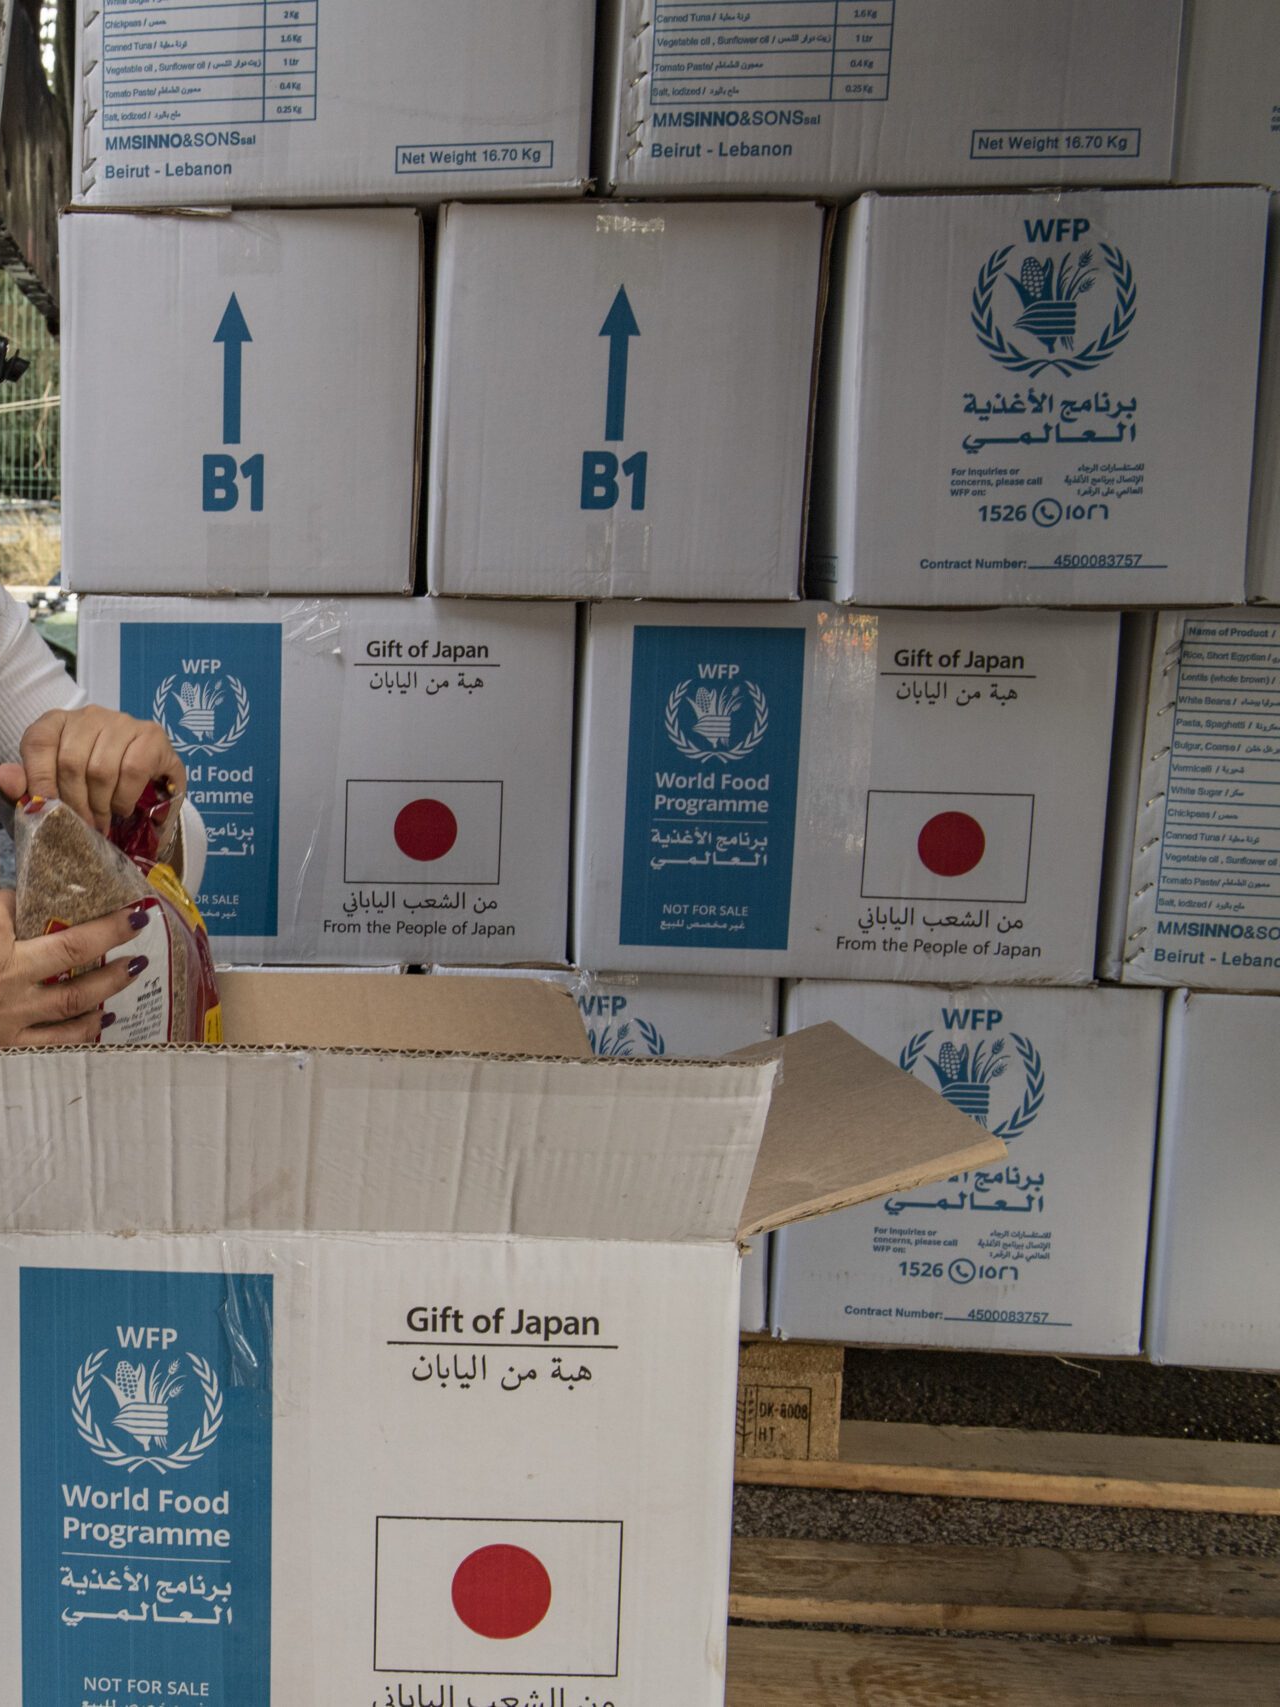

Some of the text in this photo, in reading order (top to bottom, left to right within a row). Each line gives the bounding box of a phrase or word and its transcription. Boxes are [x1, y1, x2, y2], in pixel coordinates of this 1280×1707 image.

[134, 41, 152, 50] Tuna
[106, 64, 142, 75] Vegetable
[159, 62, 195, 71] Sunflower
[105, 90, 131, 98] Tomato
[276, 106, 291, 114] 0.25
[651, 142, 793, 158] Beirut Lebanon
[978, 136, 1128, 152] Net Weight 16.70 Kg
[402, 148, 541, 165] Net Weight 16.70 Kg
[105, 162, 232, 179] Beirut Lebanon
[1024, 218, 1091, 243] WFP
[963, 387, 1137, 423] برنامج الأغذية
[962, 422, 1136, 454] العالمي
[580, 451, 648, 511] B1
[951, 468, 966, 477] For
[1009, 469, 1020, 477] or
[995, 477, 1024, 487] please
[1026, 477, 1043, 486] call
[202, 453, 264, 512] B1
[950, 488, 970, 497] WFP
[978, 504, 1027, 522] 1526
[920, 554, 1142, 570] Contract Number: 4500083757
[1188, 627, 1269, 638] Name of Product
[366, 640, 489, 662] Gift of Japan
[181, 659, 222, 674] WFP
[894, 649, 1025, 673] Gift of Japan
[697, 663, 740, 679] WFP
[369, 671, 484, 695] هبة من اليابان
[896, 680, 1018, 706] هبة من اليابان
[207, 766, 253, 783] Food
[655, 772, 770, 791] World Food
[187, 790, 253, 804] ramme
[1171, 786, 1223, 797] White Sugar
[654, 794, 769, 815] Programme
[650, 826, 768, 852] برنامج الأغذية
[1166, 831, 1222, 841] Canned Tuna
[650, 851, 768, 870] العالمي
[1165, 853, 1207, 864] Vegetable
[1209, 854, 1219, 863] oil
[1226, 855, 1266, 866] Sunflower
[211, 894, 239, 905] SALE
[342, 890, 498, 918] من الشعب الياباني
[662, 904, 749, 917] NOT FOR SALE
[858, 906, 1024, 934] من الشعب الياباني
[323, 920, 516, 939] From the People of Japan
[1157, 921, 1280, 941] MMSINNO&SO
[836, 936, 1041, 958] From the People of Japan
[1154, 948, 1205, 964] Beirut
[942, 1008, 1003, 1031] WFP
[973, 1166, 1044, 1193] برنامج
[884, 1190, 1044, 1216] العالمي
[899, 1261, 943, 1278] 1526
[406, 1306, 600, 1341] Gift of Japan
[844, 1305, 1049, 1323] Contract Number: 4500083757
[116, 1326, 178, 1350] WFP
[412, 1353, 592, 1391] هبة من اليابان
[758, 1427, 776, 1442] HT
[61, 1484, 229, 1515] World Food
[63, 1516, 231, 1549] Programme
[60, 1566, 232, 1603] برنامج الأغذية
[61, 1601, 233, 1627] العالمي
[83, 1676, 210, 1697] NOT FOR SALE
